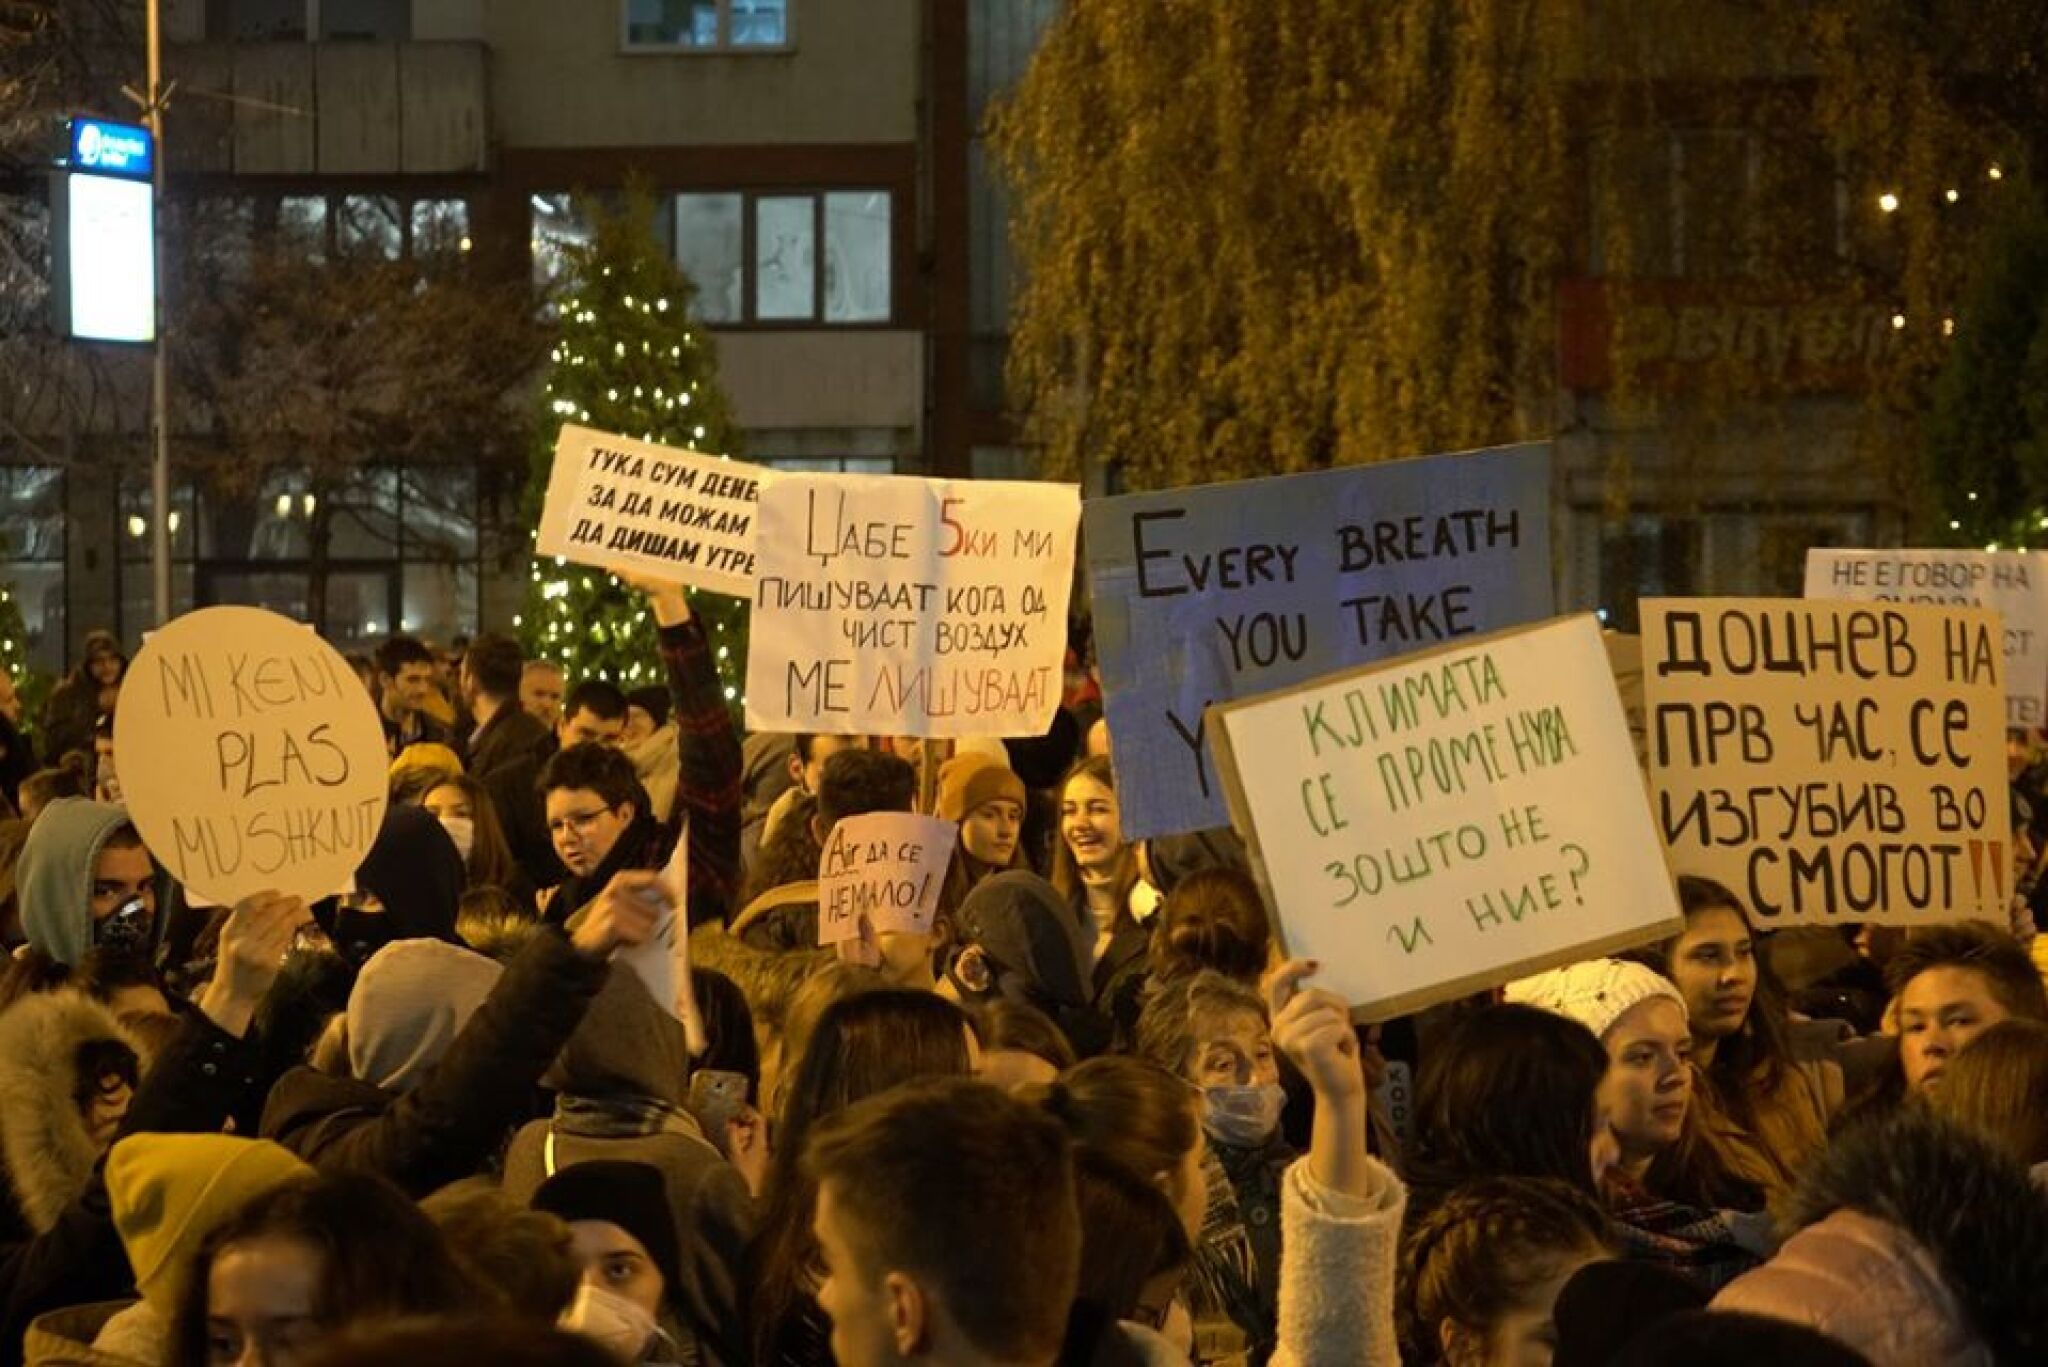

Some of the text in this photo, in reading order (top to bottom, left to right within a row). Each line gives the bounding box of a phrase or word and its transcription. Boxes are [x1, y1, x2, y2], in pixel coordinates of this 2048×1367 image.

[589, 448, 758, 502] ТУКА СУМ ДЕНЕ
[570, 519, 605, 544] ДА
[607, 526, 701, 564] ДИШАМ
[587, 484, 750, 536] ЗА ДА МОЖАМ
[807, 488, 914, 568] ЦАБЕ
[1013, 529, 1052, 557] МИ
[1132, 509, 1519, 597] EVERY BREATH
[1833, 560, 2031, 589] НЕ Е ГОВОР НА
[758, 577, 937, 611] ПИШУВААТ
[947, 585, 1005, 615] КОГА
[1217, 586, 1476, 671] YOU TAKE
[843, 619, 1028, 659] ЧИСТ ВОЗДУХ
[1945, 617, 1997, 687] НА
[2003, 629, 2034, 656] СТ
[158, 650, 343, 718] MI KENI
[786, 660, 1052, 717] МЕ ЛИШУВААТ
[1302, 653, 1508, 756] КЛИМАТА
[217, 723, 349, 798] PLAS
[1166, 701, 1213, 797] Y
[1656, 702, 1775, 768] ПРВ
[172, 797, 380, 880] MUSHKNIT
[1301, 774, 1349, 838] СЕ
[1659, 782, 1987, 847] ИЗГУБИВ ВО
[866, 840, 889, 863] ДА
[898, 843, 923, 863] СЕ
[1324, 805, 1550, 908] ЗОШТО НЕ
[1748, 839, 2005, 916] СМОГОТ!!
[828, 872, 931, 924] НЕМАЛО!
[1387, 843, 1591, 954] И НИЕ?
